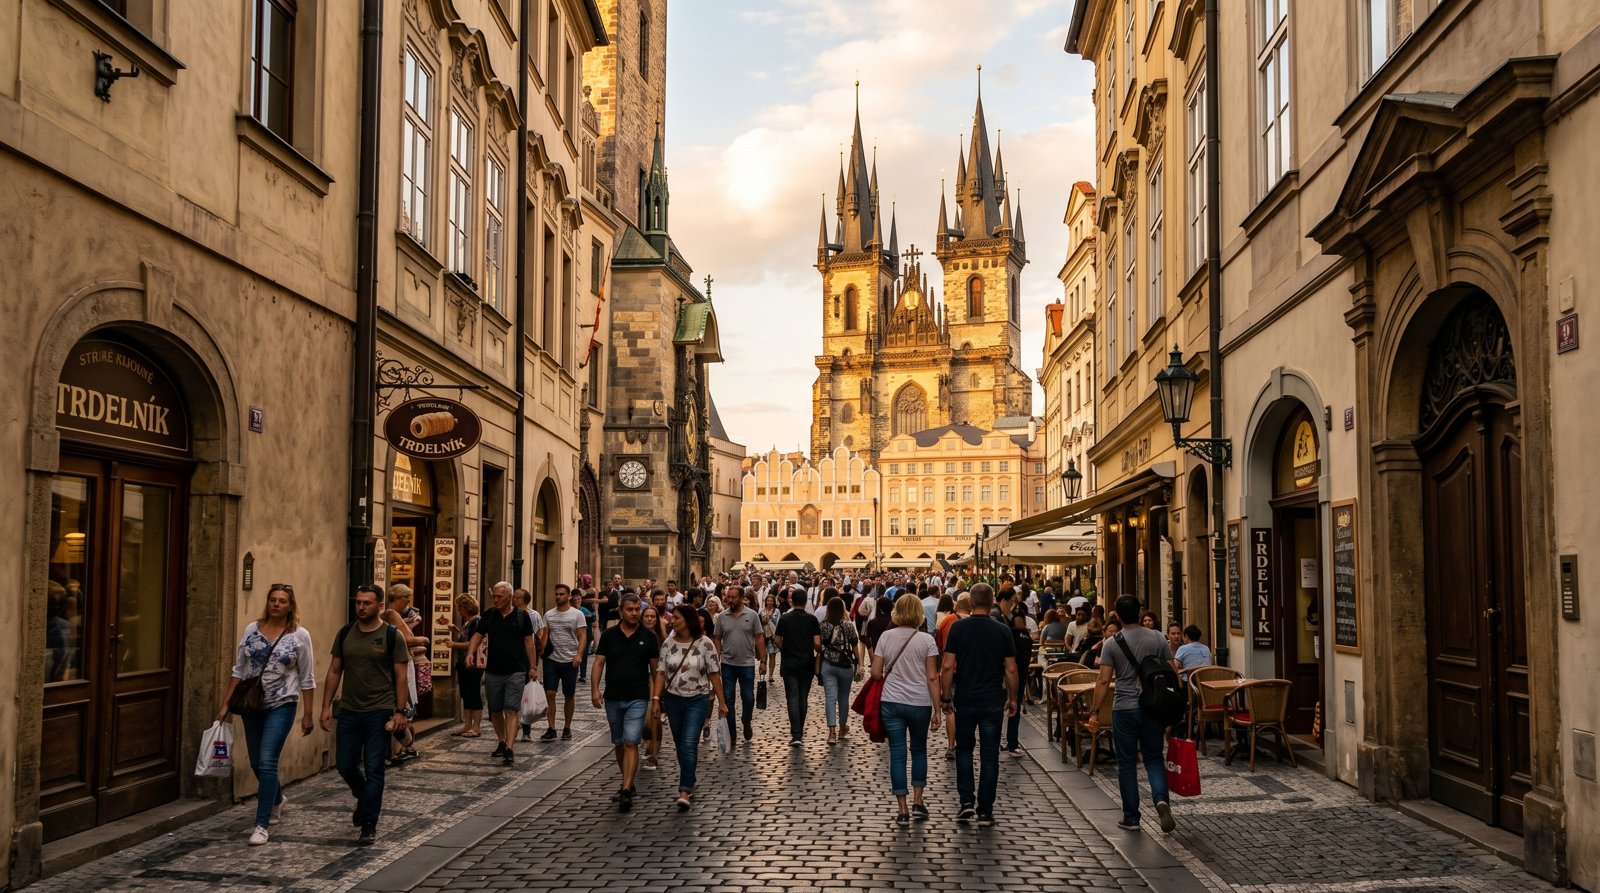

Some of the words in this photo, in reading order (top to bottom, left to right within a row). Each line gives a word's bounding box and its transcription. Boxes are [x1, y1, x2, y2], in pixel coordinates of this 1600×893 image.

[57, 382, 170, 436] TRDELNÍK
[399, 436, 466, 454] TRDELNÍK
[1255, 531, 1270, 633] TRDELNIK
